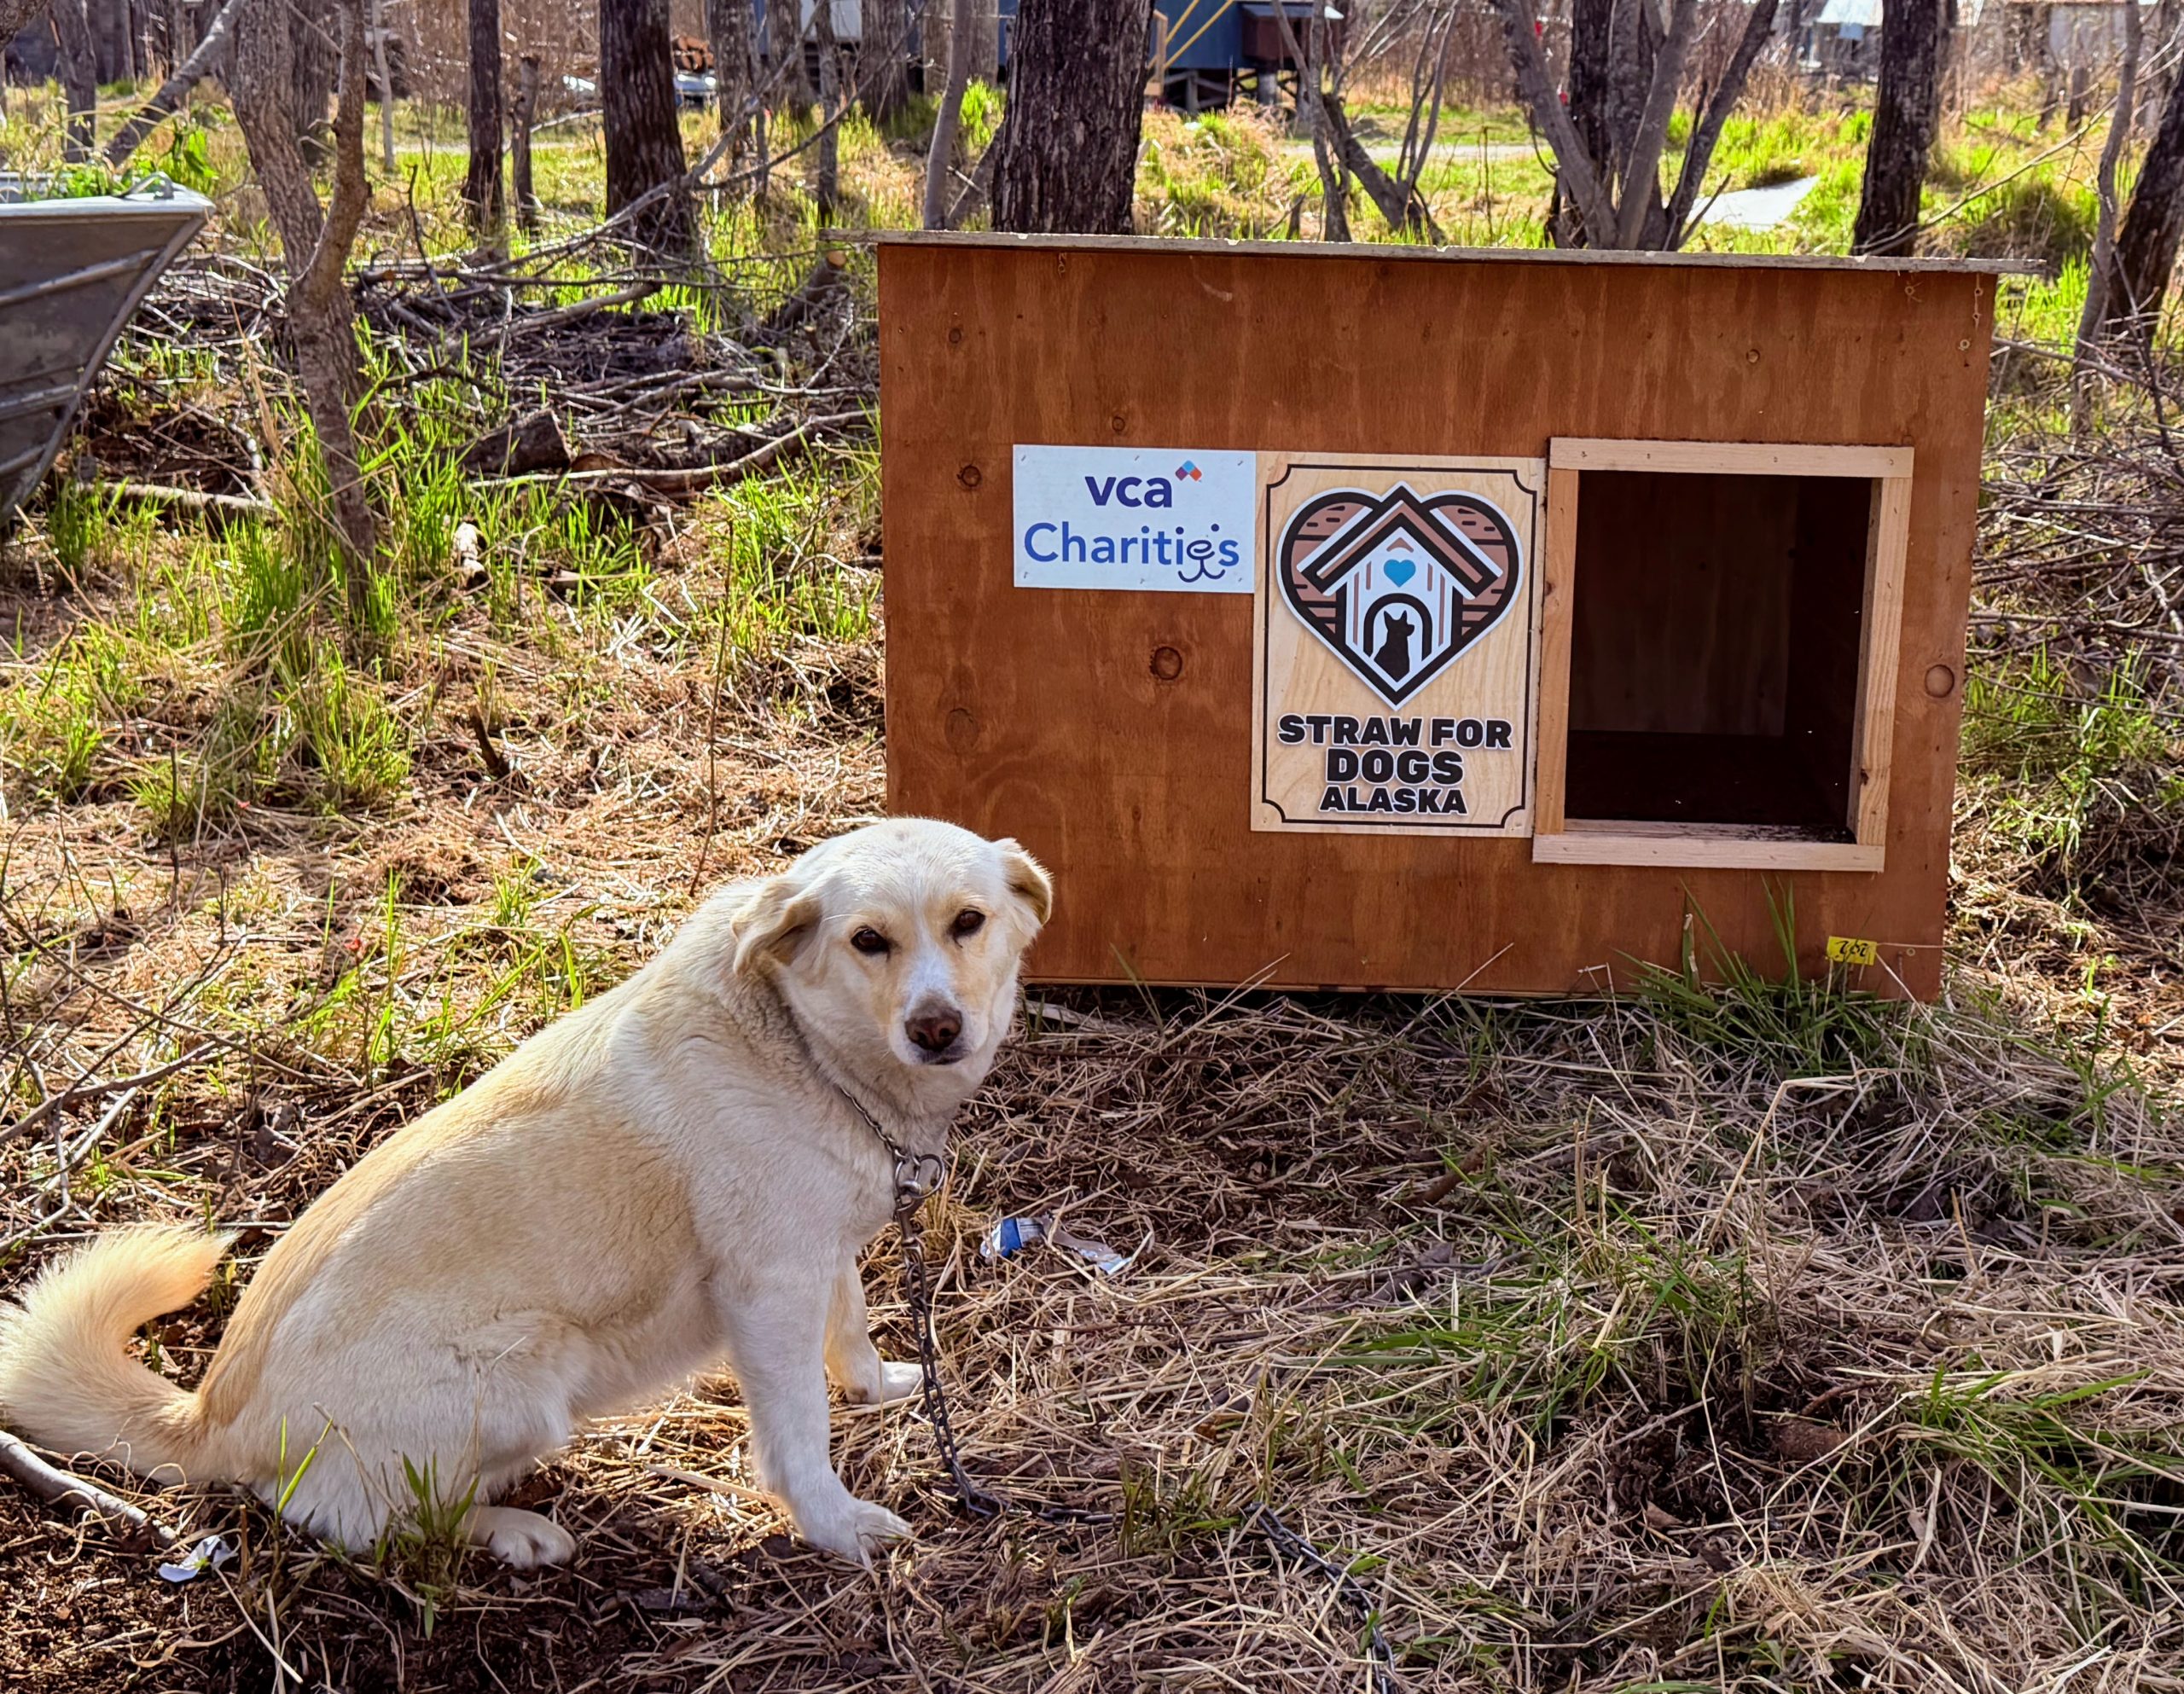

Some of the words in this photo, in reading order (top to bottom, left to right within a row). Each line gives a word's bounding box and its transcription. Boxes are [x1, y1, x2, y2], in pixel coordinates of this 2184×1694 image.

[1085, 475, 1172, 508] vca
[1024, 521, 1240, 583] Charities
[1279, 715, 1422, 746] STRAW
[1431, 719, 1512, 748] FOR
[1327, 749, 1464, 784] DOGS
[1319, 786, 1467, 815] ALASKA
